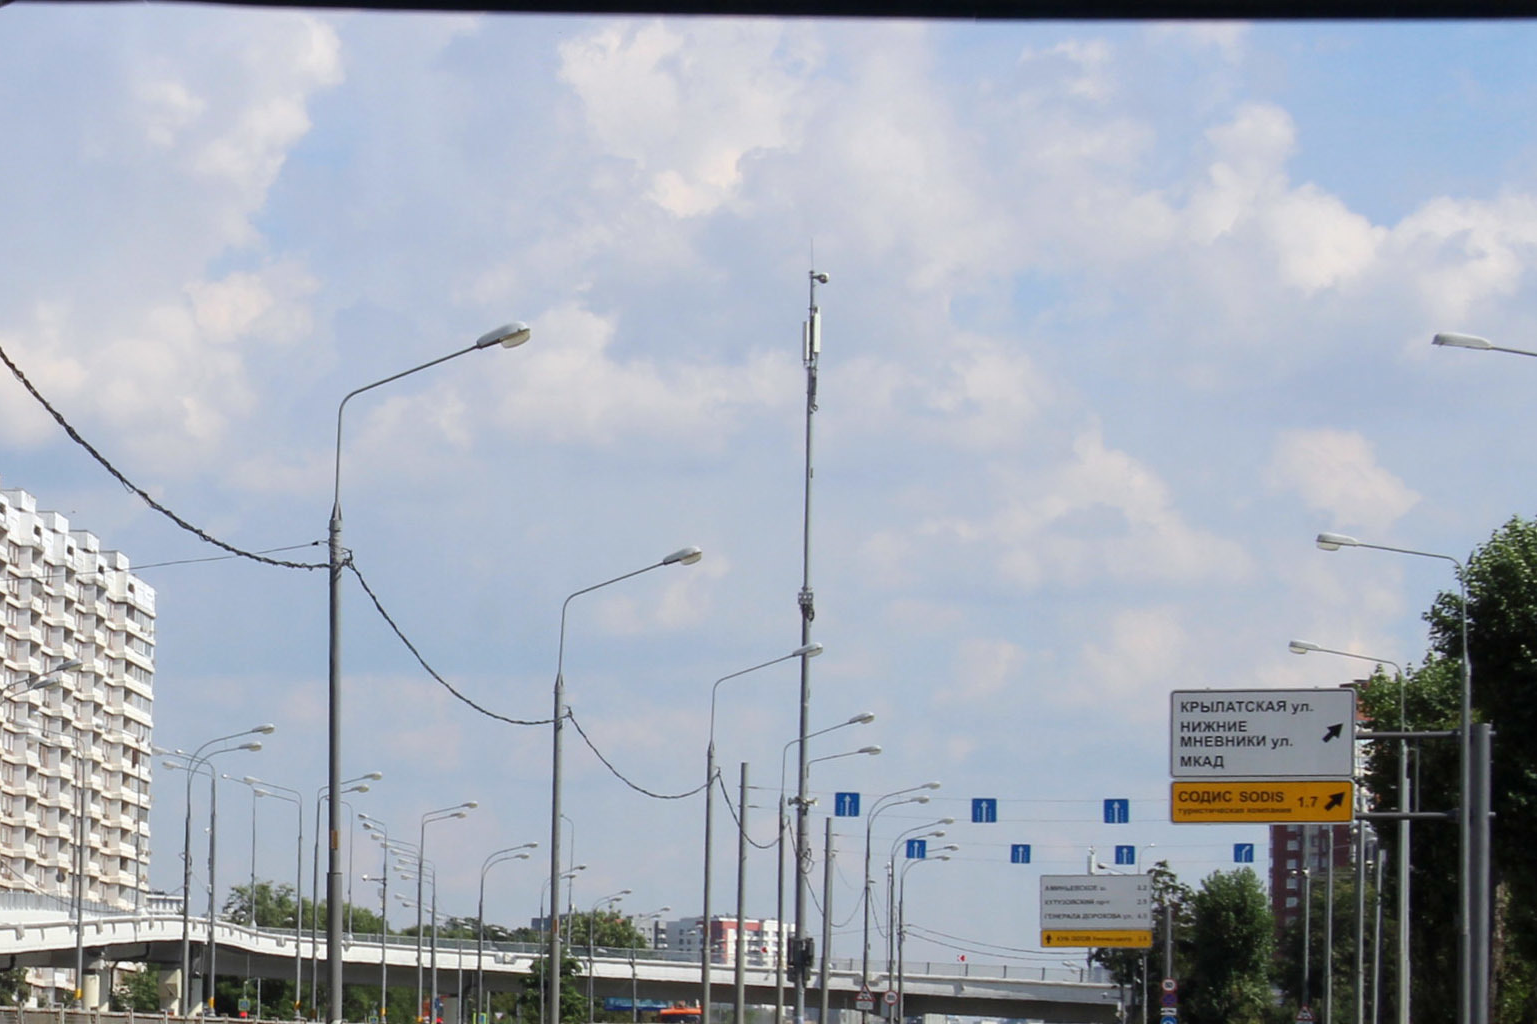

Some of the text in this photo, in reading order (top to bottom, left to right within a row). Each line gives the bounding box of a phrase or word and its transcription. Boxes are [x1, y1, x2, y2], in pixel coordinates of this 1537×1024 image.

[1180, 701, 1314, 715] КРЫЛАТСКАЯ ул.
[1180, 721, 1247, 733] НИЖНИЕ
[1180, 736, 1293, 750] МНЕВНИКИ ул.
[1180, 756, 1224, 769] МКАД
[1178, 791, 1284, 804] СОДИС SODIS
[1297, 796, 1318, 808] 1.7
